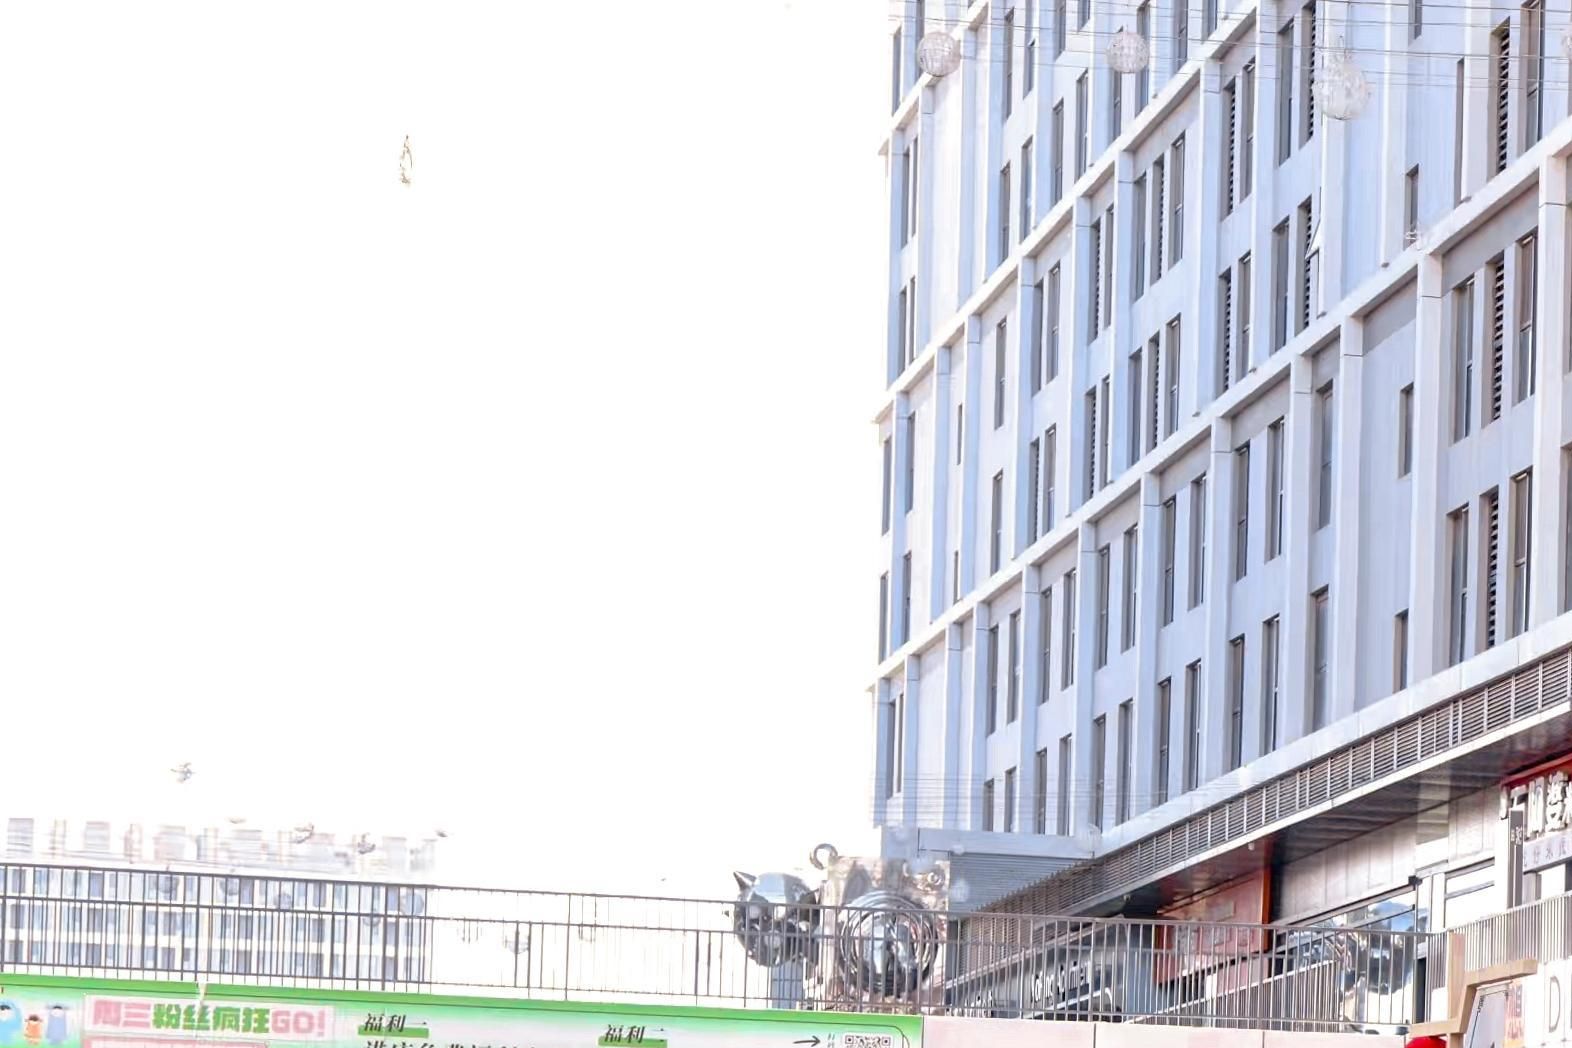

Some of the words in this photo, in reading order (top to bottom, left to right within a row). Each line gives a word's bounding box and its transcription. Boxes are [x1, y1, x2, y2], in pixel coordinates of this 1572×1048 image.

[364, 1012, 428, 1033] 福利一
[605, 1023, 665, 1044] 福利二
